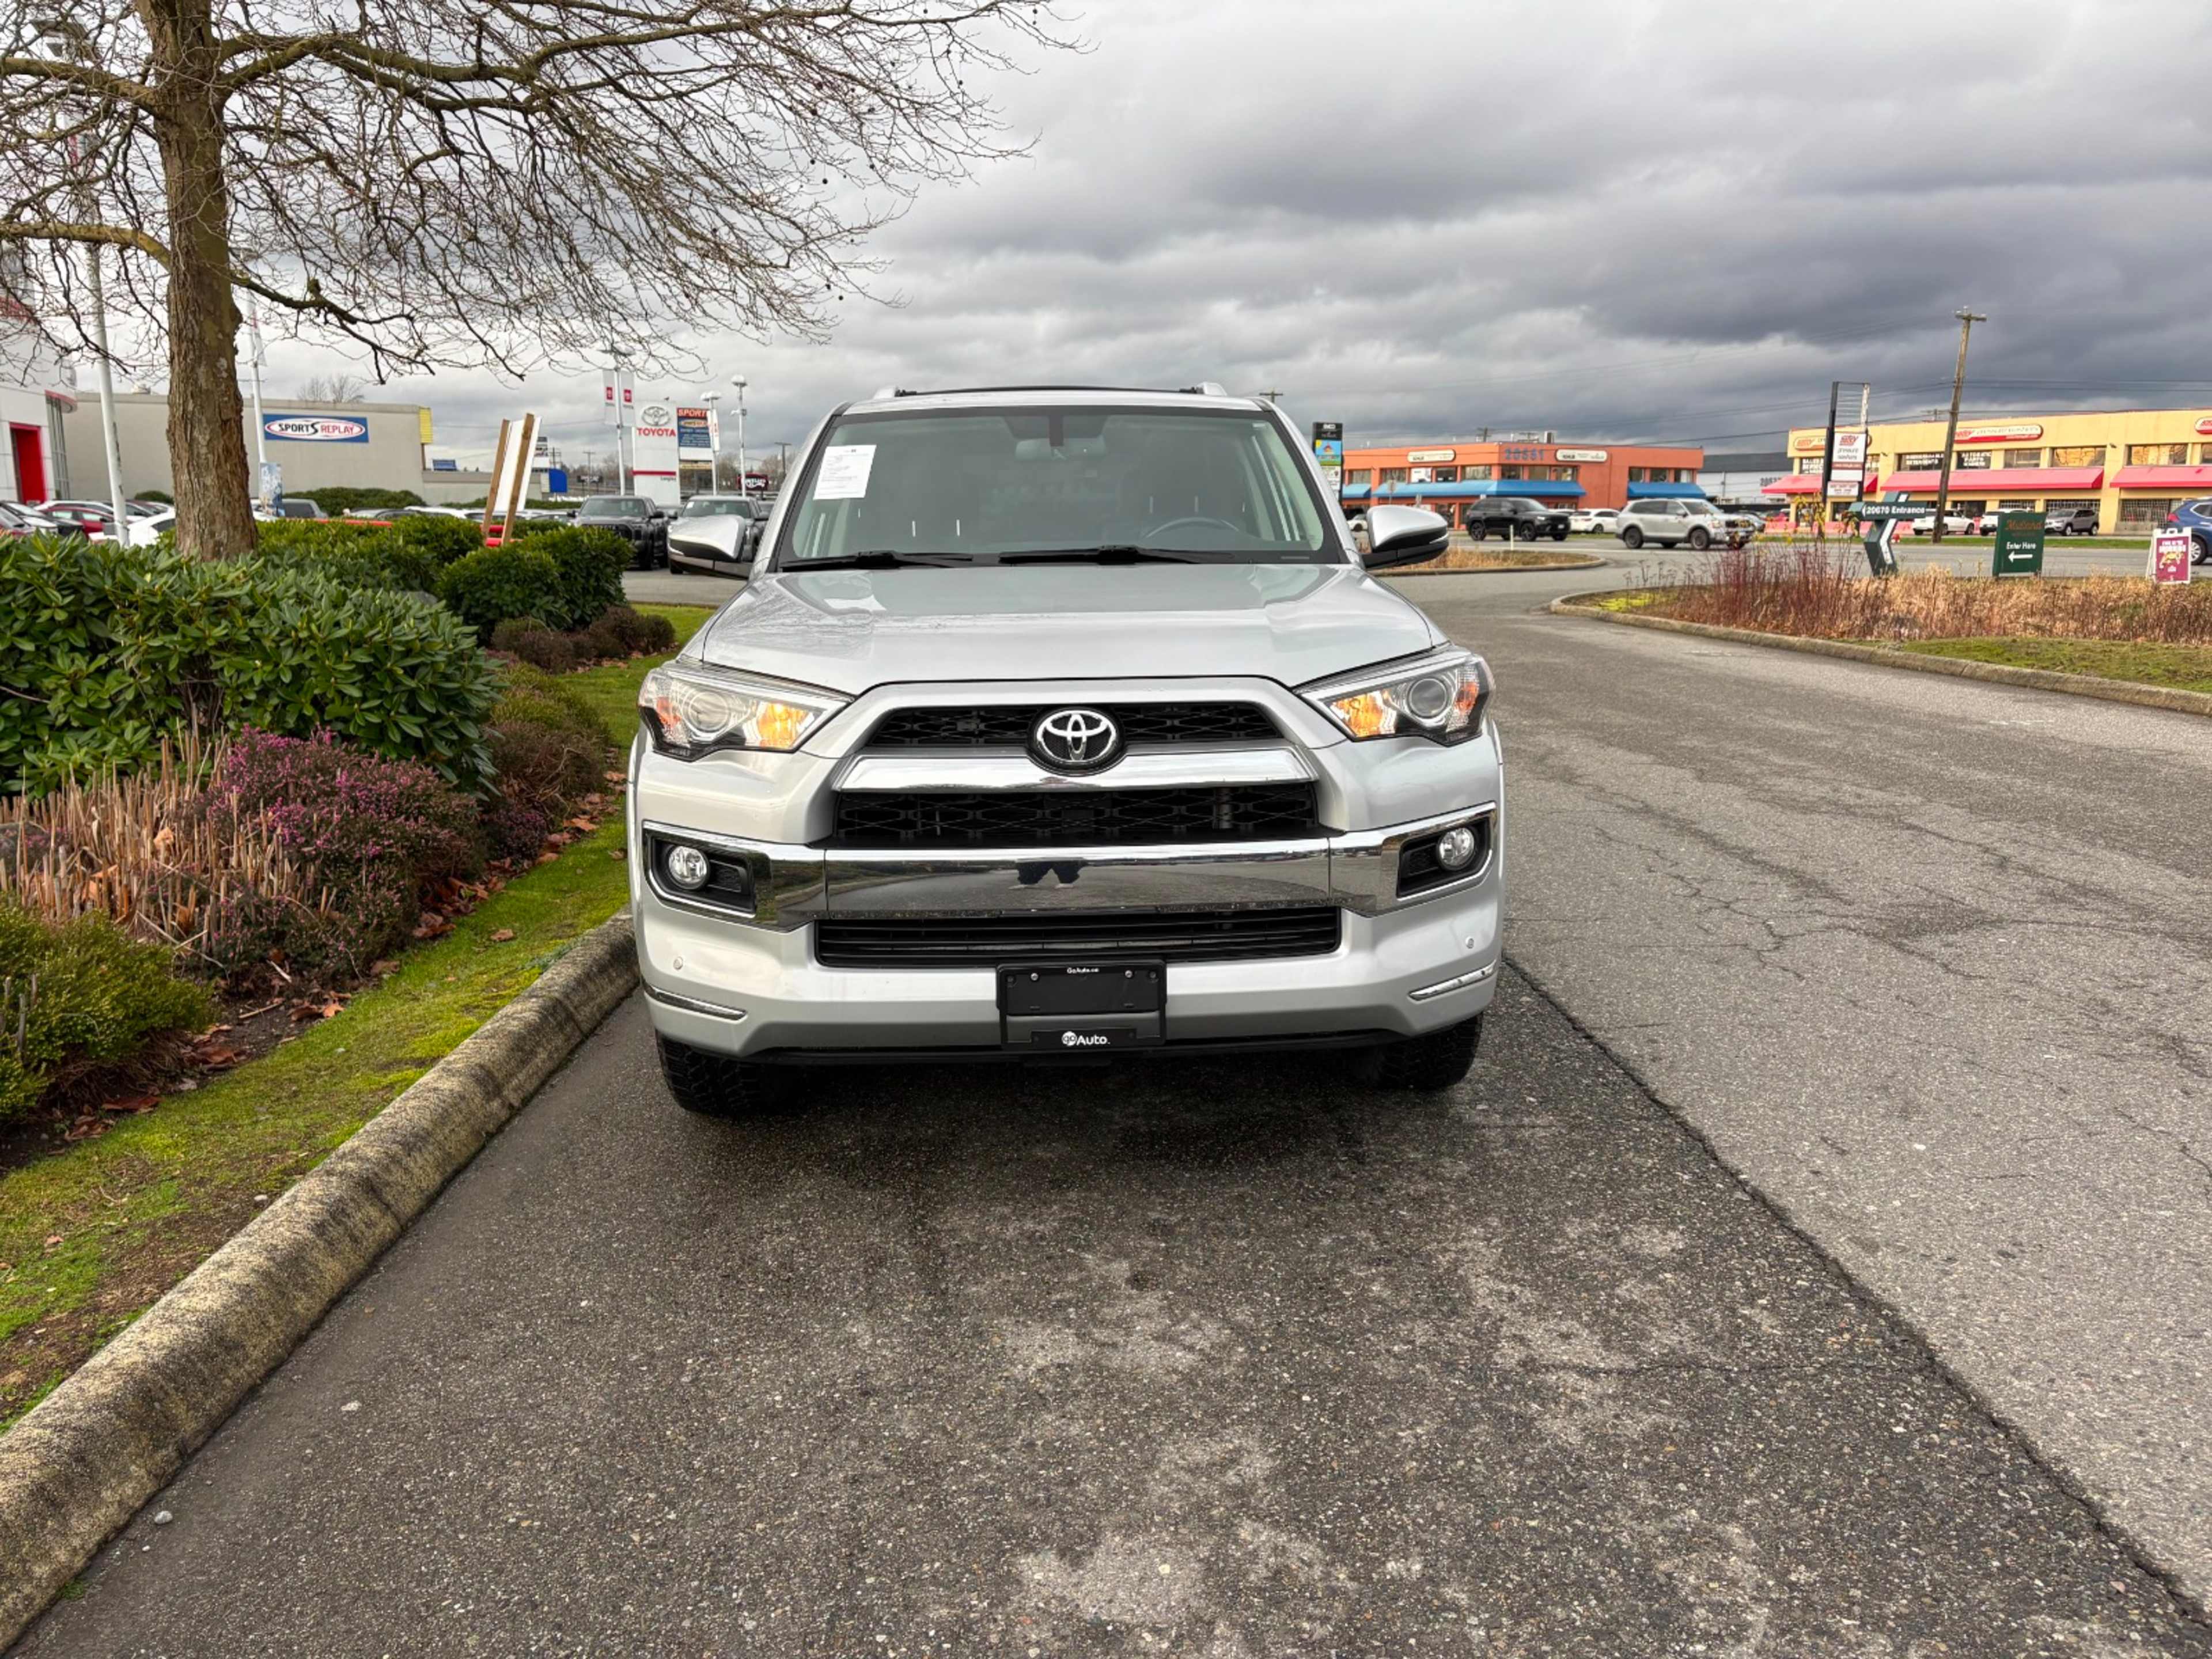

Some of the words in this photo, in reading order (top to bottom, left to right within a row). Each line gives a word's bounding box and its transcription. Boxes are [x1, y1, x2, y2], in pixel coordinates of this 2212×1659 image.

[678, 408, 707, 417] SPORT
[278, 421, 319, 435] SPORTS
[320, 425, 354, 434] REPLAY
[637, 428, 676, 437] TOYOTA
[1891, 506, 1925, 514] Entrance
[2006, 541, 2021, 550] Enter
[2022, 541, 2036, 550] Here
